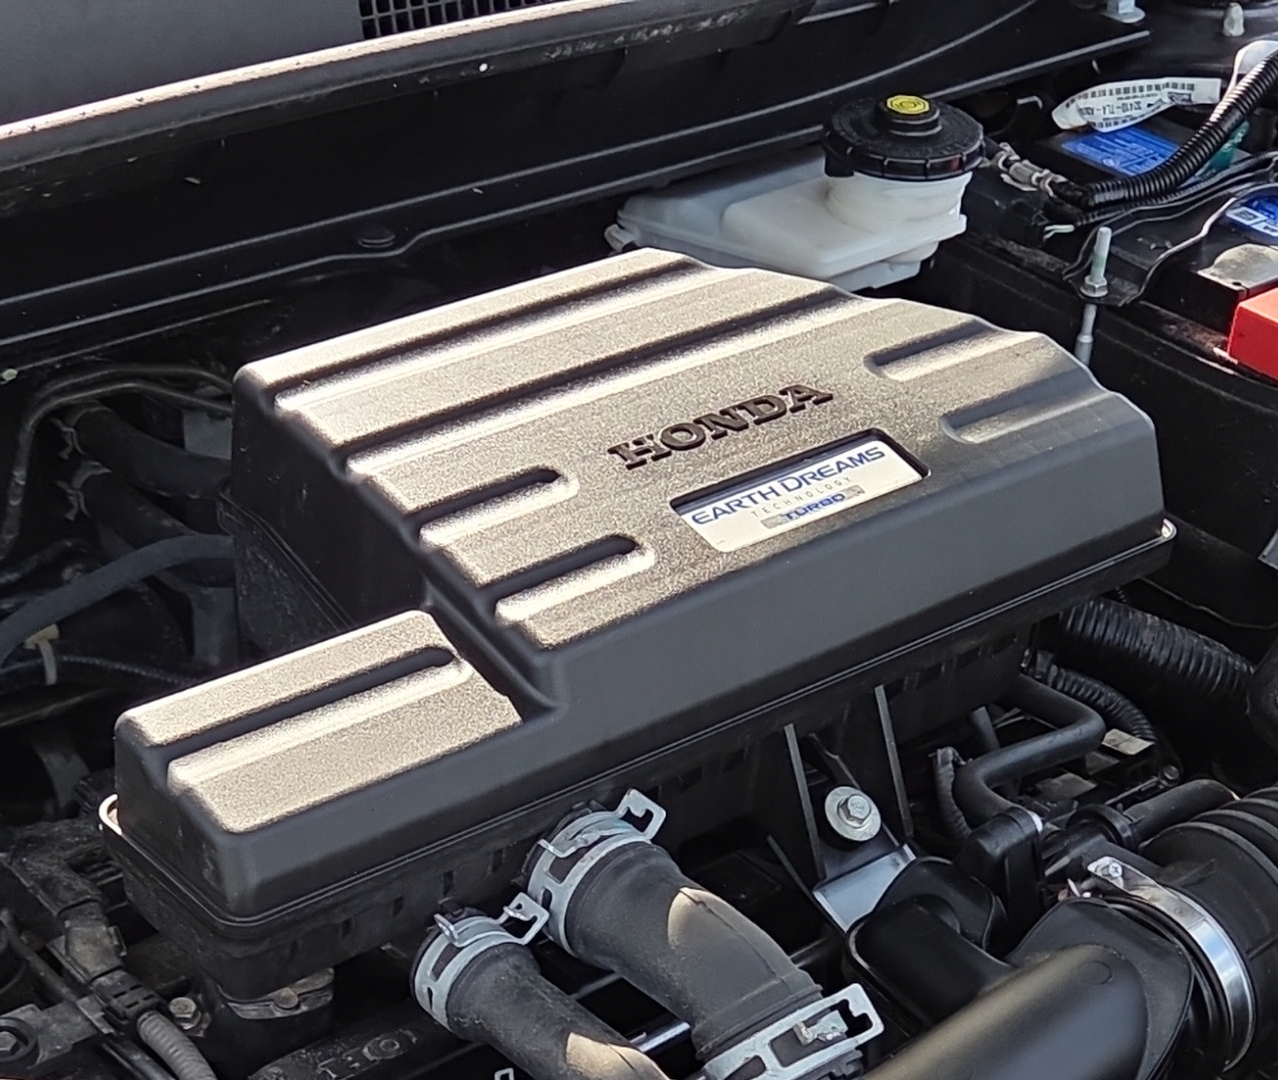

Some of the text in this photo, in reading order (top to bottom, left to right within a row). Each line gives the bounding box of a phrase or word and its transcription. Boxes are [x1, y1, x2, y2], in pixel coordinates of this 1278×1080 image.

[608, 384, 834, 470] HONDA
[692, 447, 885, 525] EARTH DREAMS
[751, 476, 853, 517] TECHNOLOGY
[783, 492, 846, 522] TURBO
